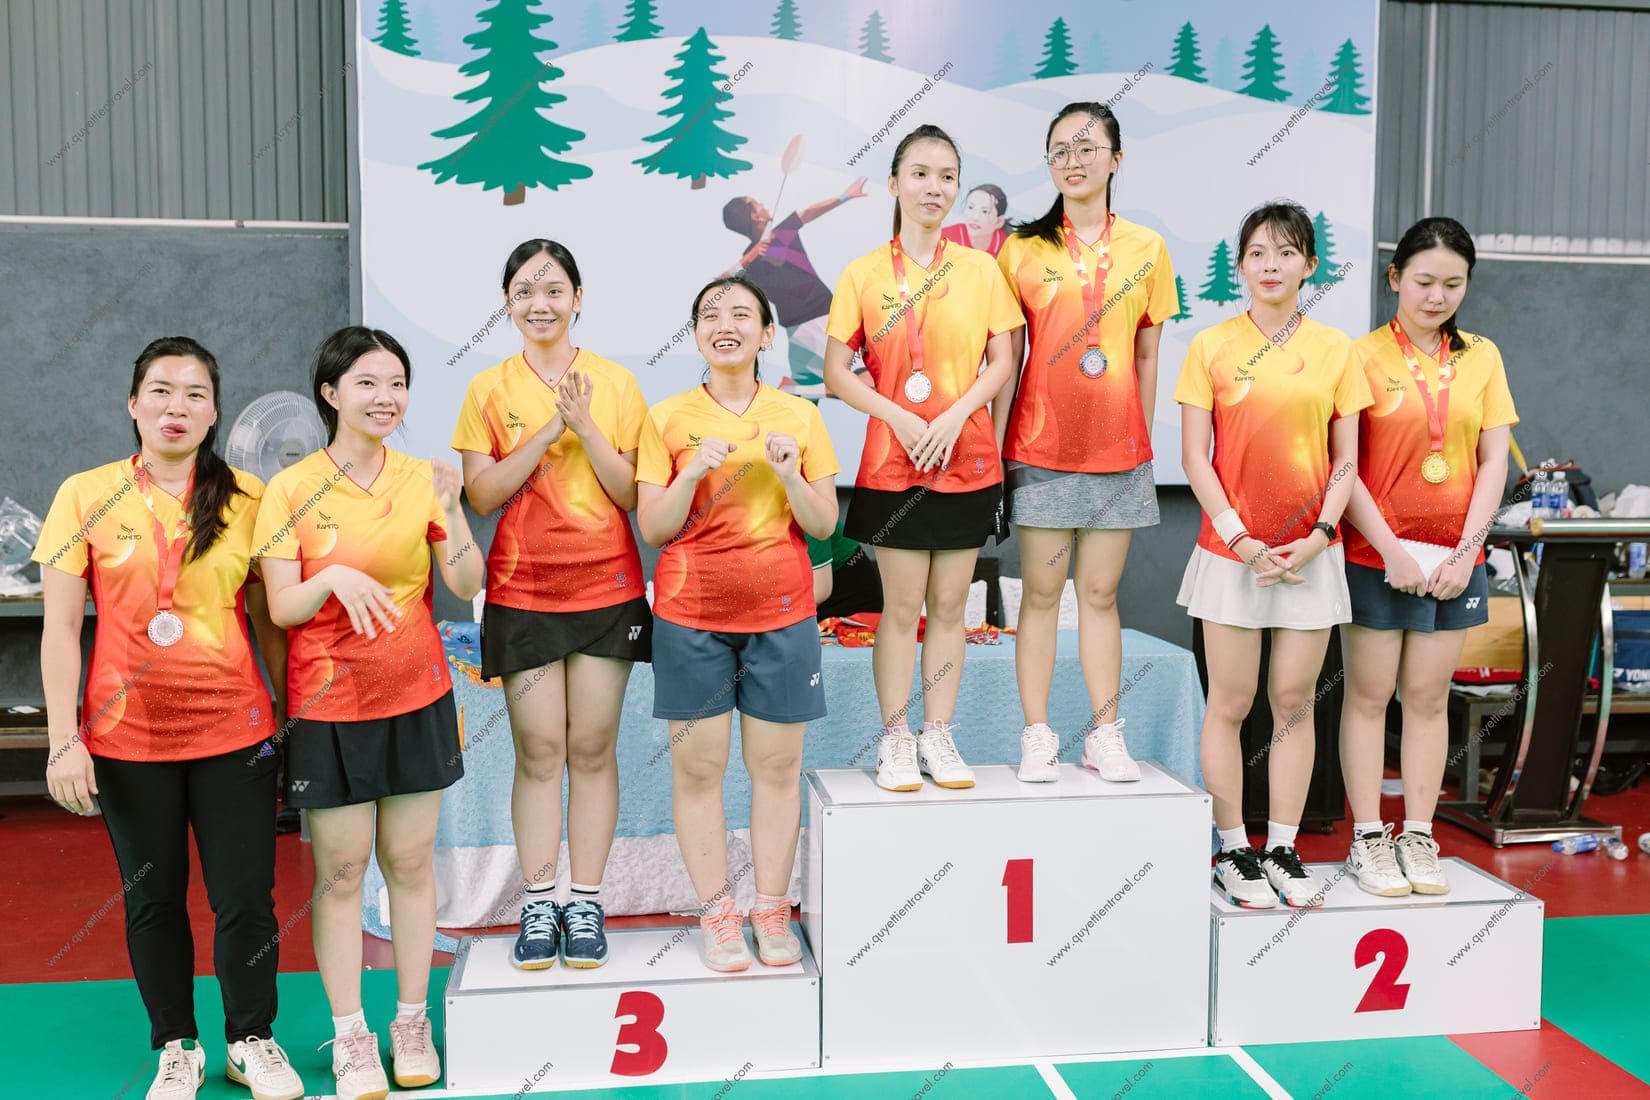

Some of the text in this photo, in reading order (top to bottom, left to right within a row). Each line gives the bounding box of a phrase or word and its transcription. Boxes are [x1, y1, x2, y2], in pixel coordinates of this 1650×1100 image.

[1001, 859, 1033, 944] 1
[1354, 928, 1411, 1013] 2
[610, 991, 668, 1076] 3
